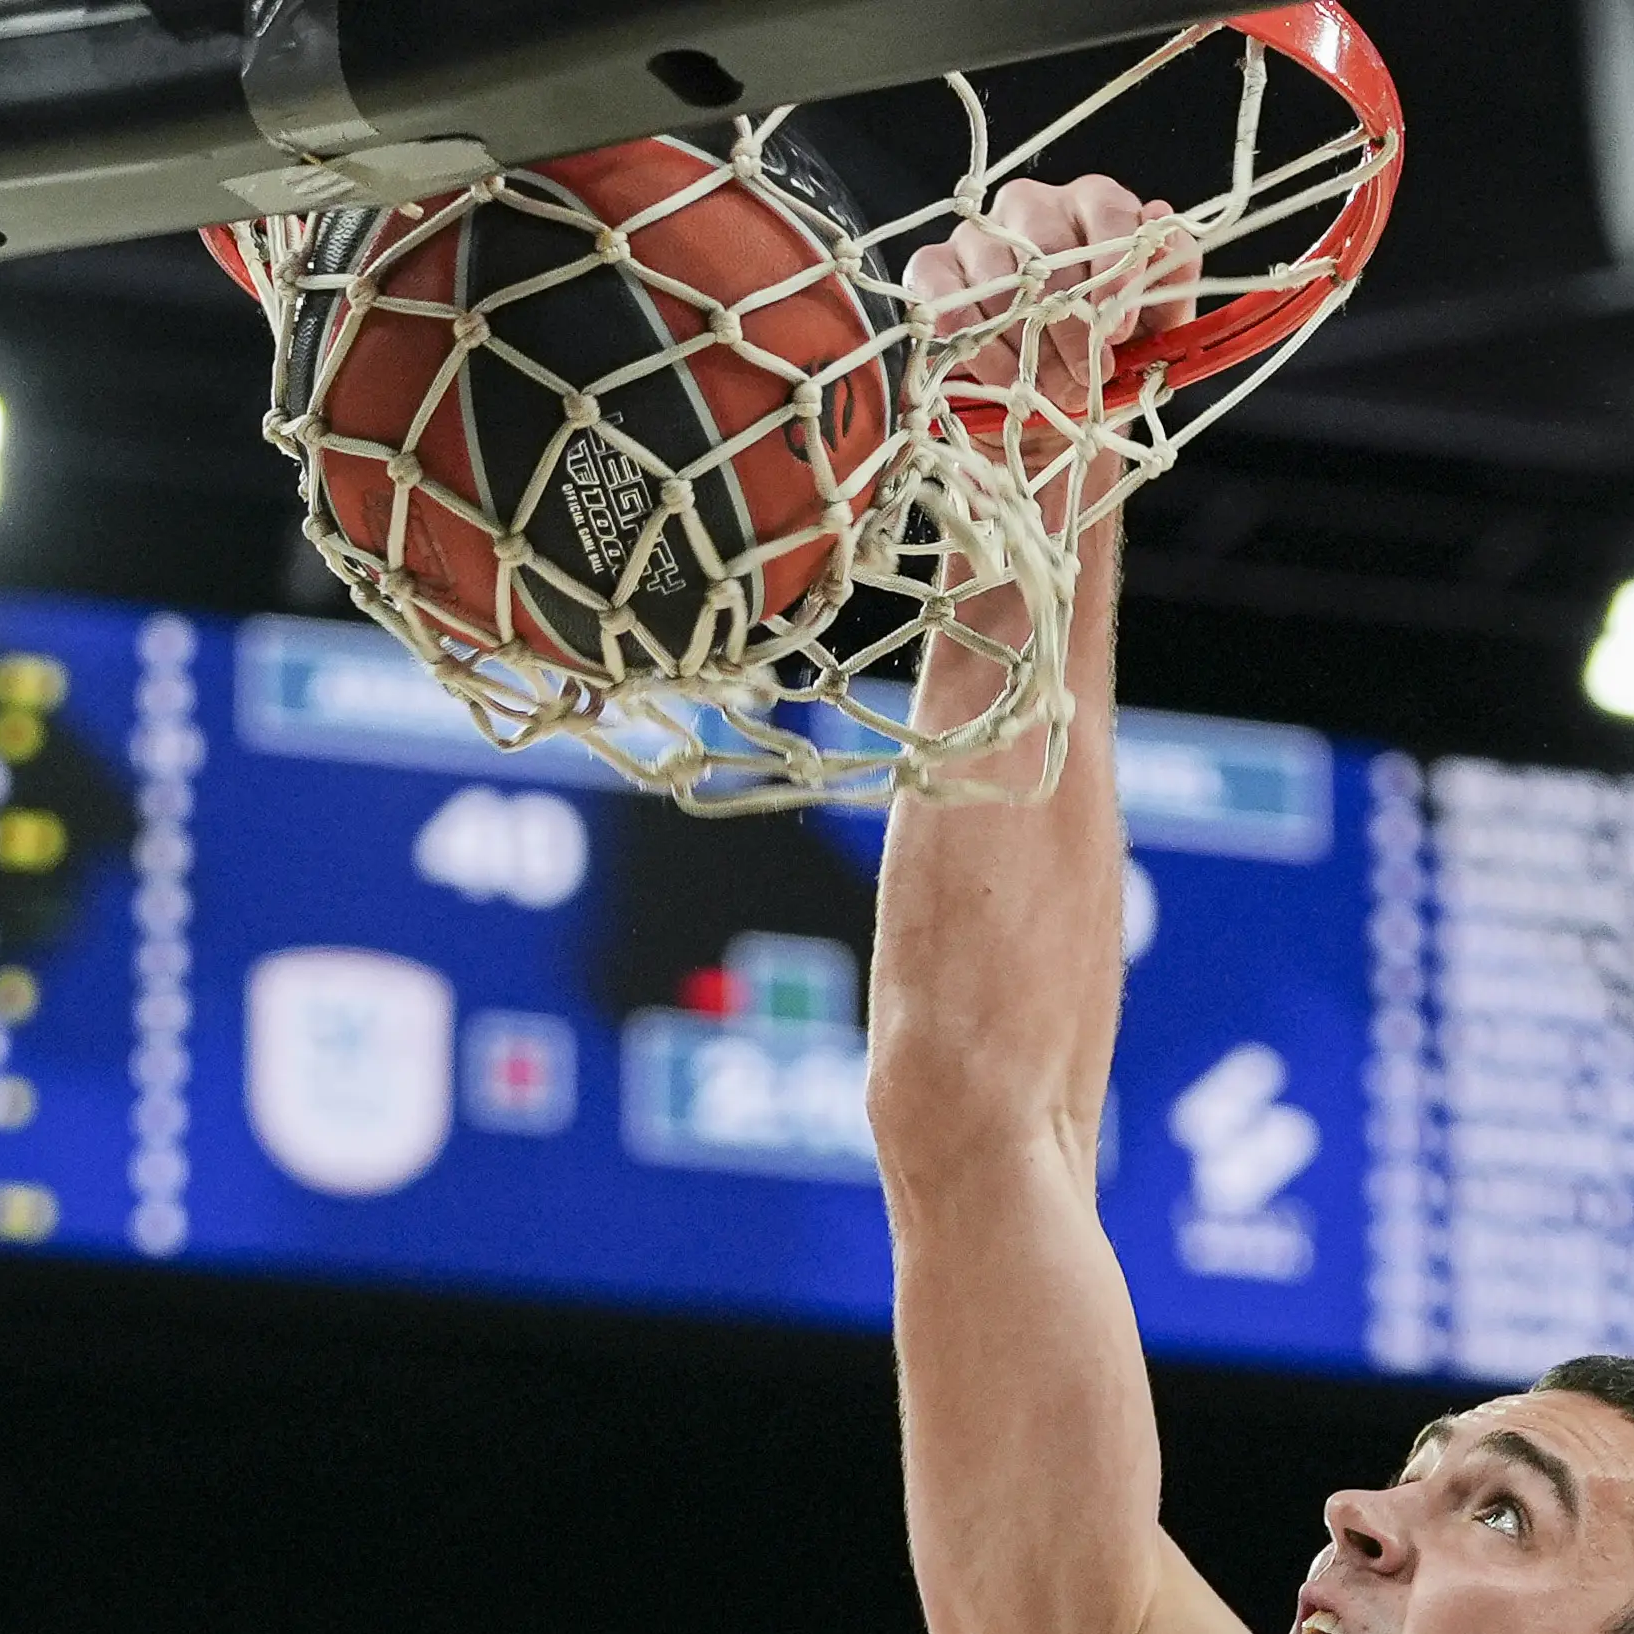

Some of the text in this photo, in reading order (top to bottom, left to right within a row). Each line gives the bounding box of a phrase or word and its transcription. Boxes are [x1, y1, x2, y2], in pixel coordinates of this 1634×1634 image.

[561, 483, 605, 576] OFFICIAL GAME BALL
